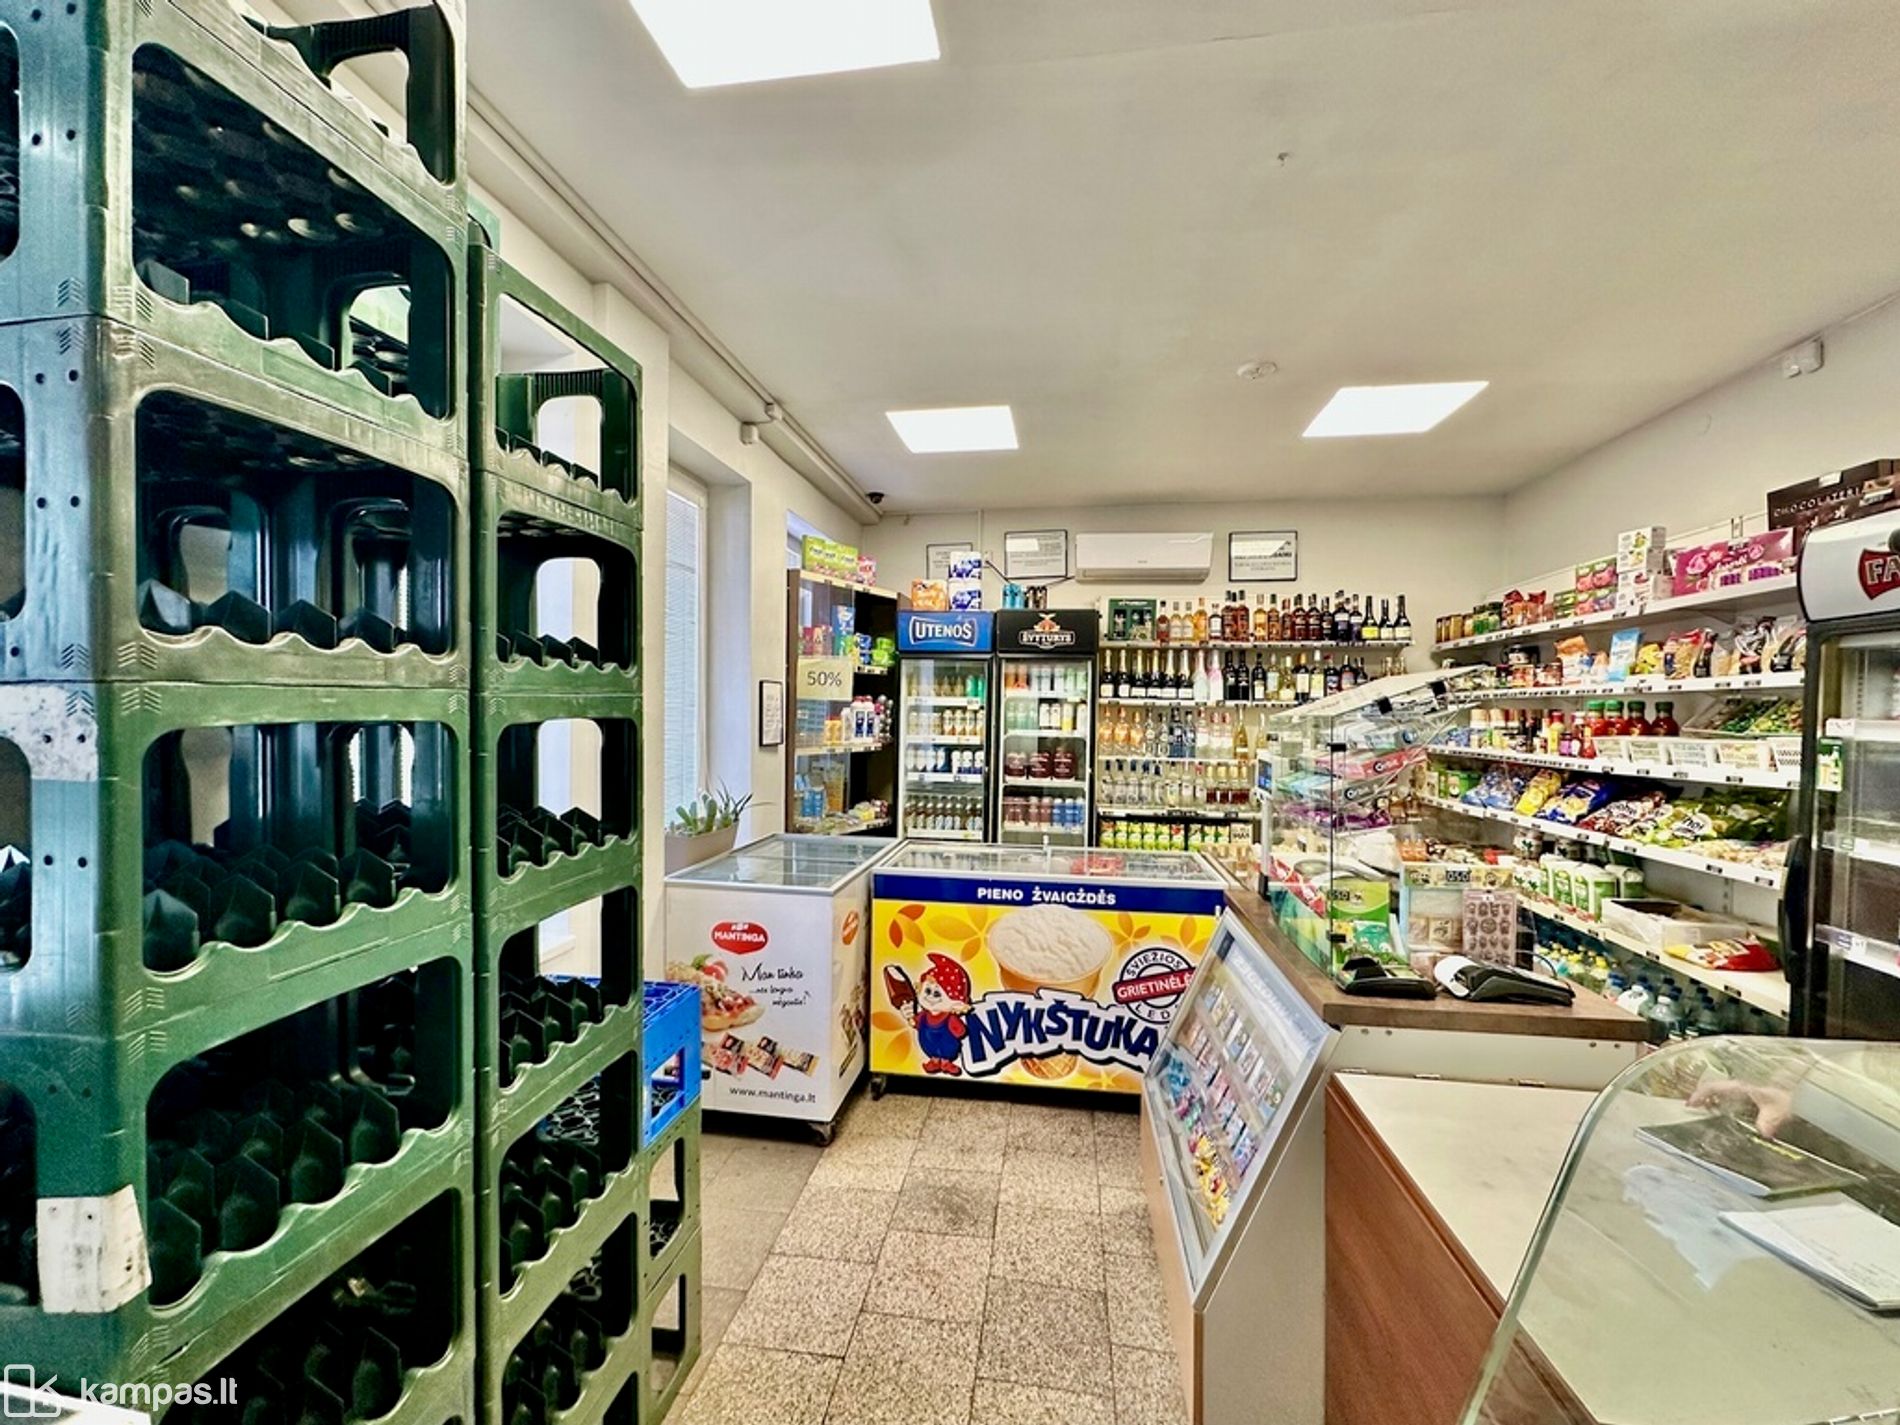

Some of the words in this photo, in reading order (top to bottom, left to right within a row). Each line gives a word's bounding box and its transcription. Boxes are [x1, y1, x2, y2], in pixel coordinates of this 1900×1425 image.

[1864, 554, 1900, 586] FA
[914, 621, 972, 640] UTENOS
[807, 670, 842, 687] 50%
[977, 887, 1024, 901] PIENO
[1032, 885, 1117, 906] ŽVAIGŽDĖS
[714, 931, 766, 944] MANTINGA
[741, 962, 775, 982] Man
[1117, 972, 1194, 998] GRIETINĖLĖ
[1135, 1003, 1171, 1020] LED
[965, 999, 1160, 1065] NYKŠTUKA
[729, 1087, 816, 1104] www.mantinga.lt
